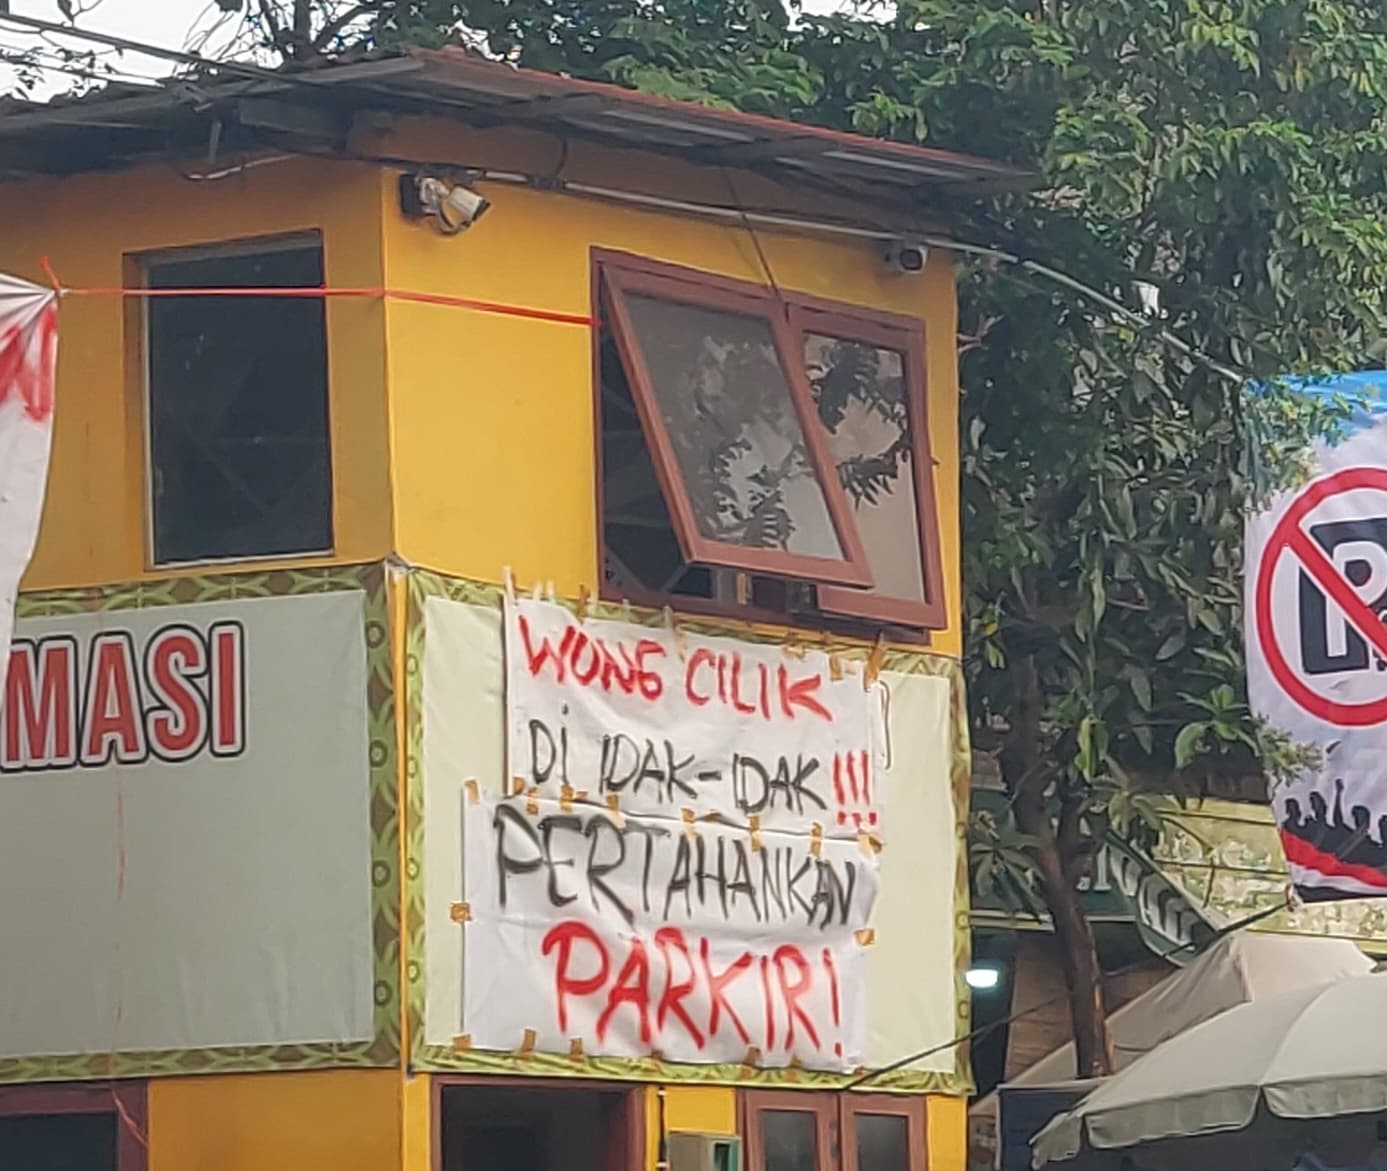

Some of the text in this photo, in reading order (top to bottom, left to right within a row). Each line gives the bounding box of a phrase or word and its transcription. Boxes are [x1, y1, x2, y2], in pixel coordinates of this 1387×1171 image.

[685, 648, 834, 722] CILIK
[493, 803, 857, 930] PERTAHANKAN
[541, 920, 844, 1058] PARKIR!
